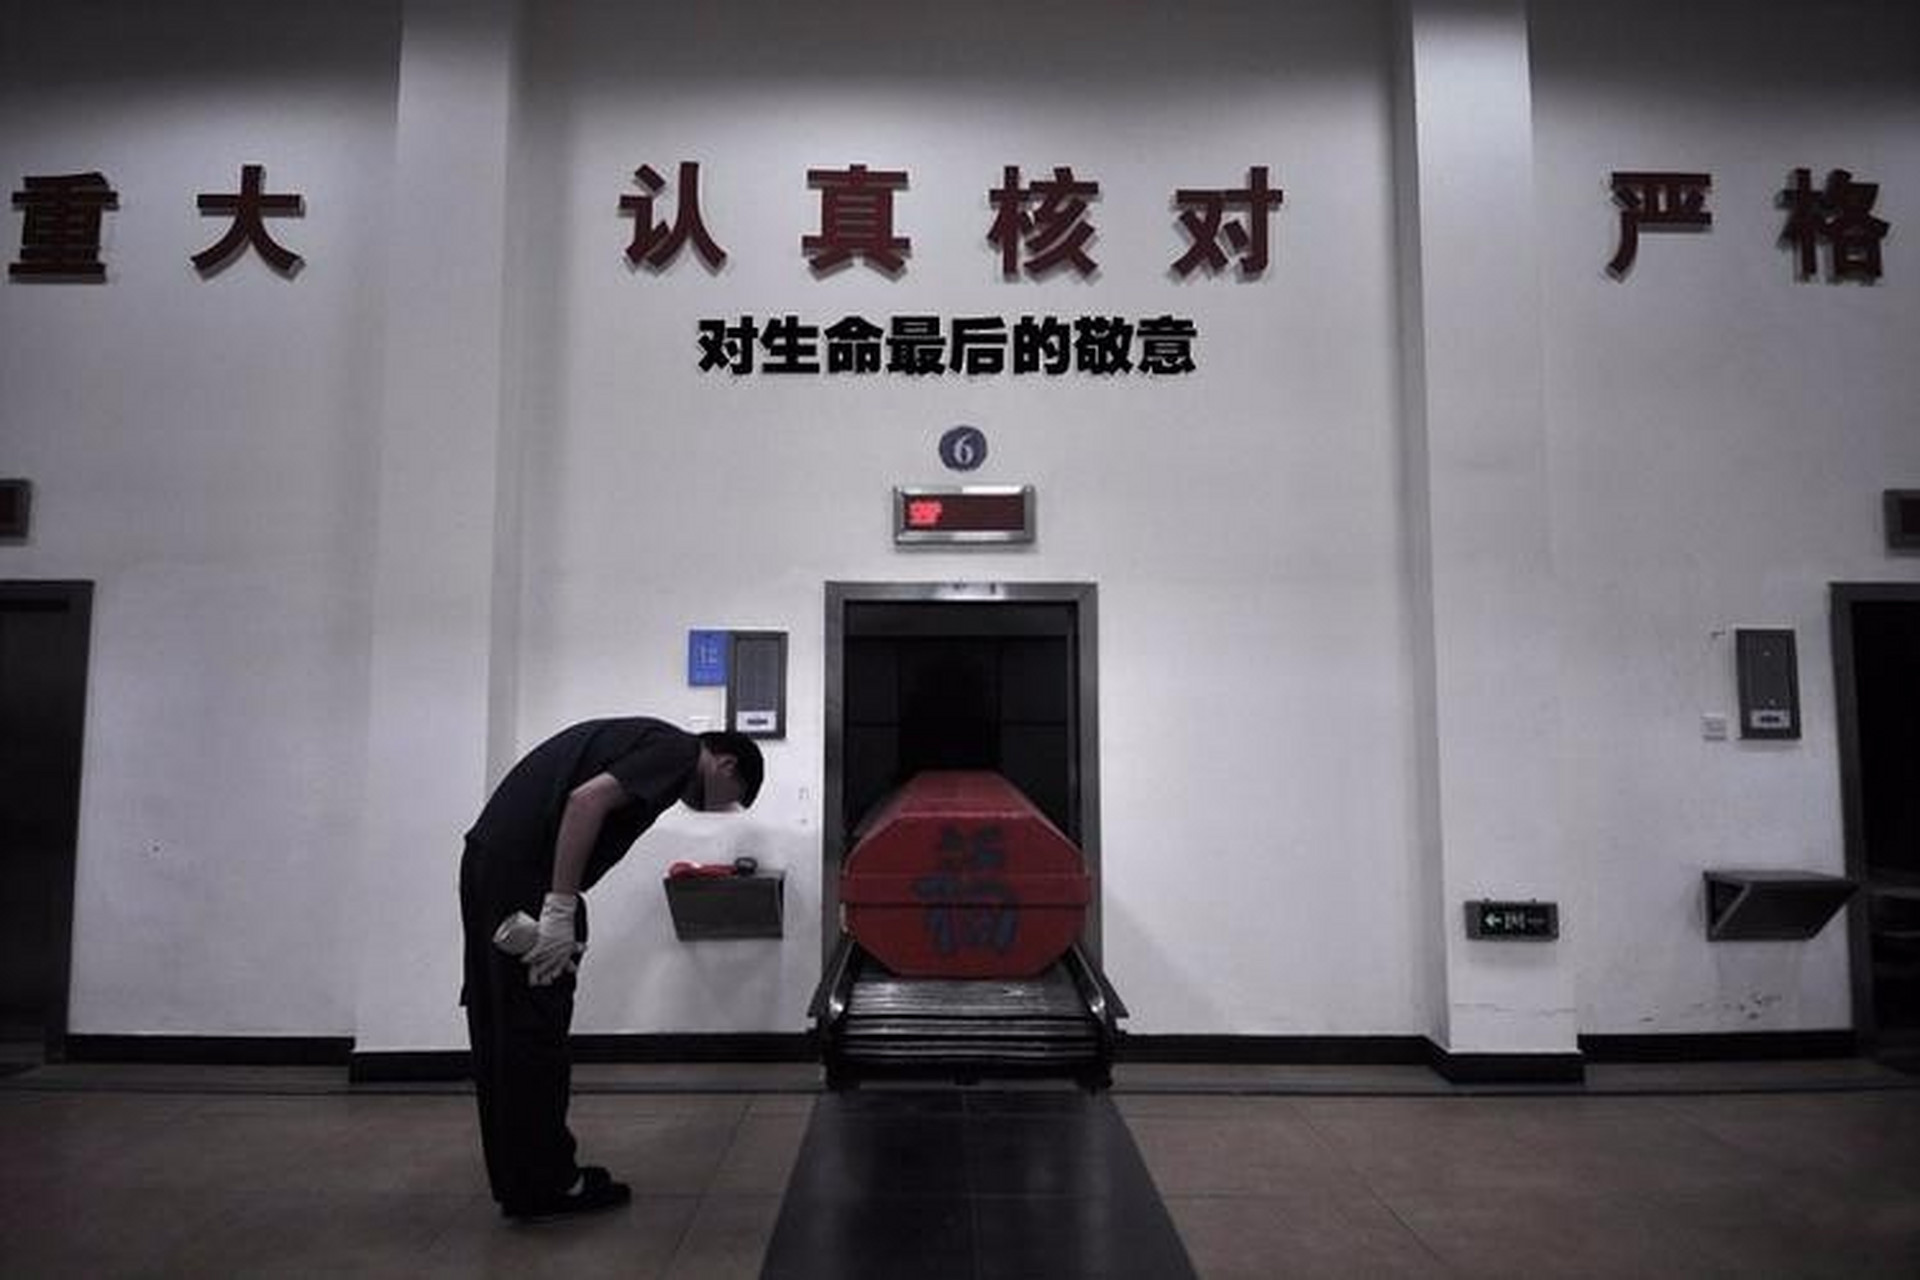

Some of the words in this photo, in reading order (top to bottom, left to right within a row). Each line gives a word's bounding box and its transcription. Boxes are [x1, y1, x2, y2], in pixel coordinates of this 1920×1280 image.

[9, 165, 305, 282] 重大
[618, 161, 1284, 280] 认真核对
[1605, 168, 1891, 284] 严格
[698, 315, 1197, 375] 对生命最后的敬意
[953, 432, 975, 465] 6
